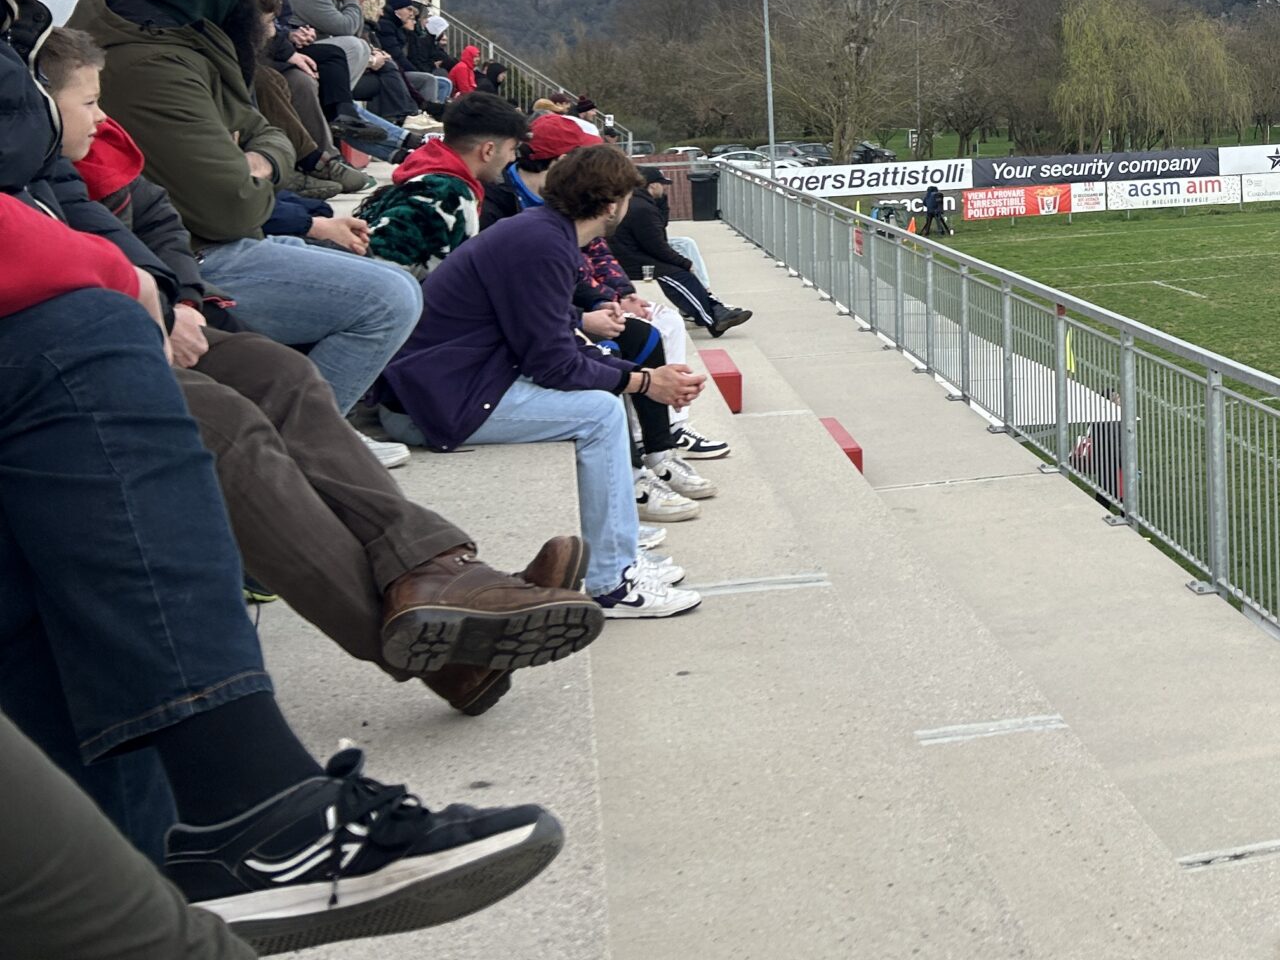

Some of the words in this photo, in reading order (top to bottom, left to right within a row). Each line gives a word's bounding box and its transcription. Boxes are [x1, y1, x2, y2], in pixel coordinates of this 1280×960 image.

[992, 163, 1036, 179] Your
[1040, 159, 1114, 178] security
[1118, 157, 1201, 176] company
[1187, 179, 1222, 194] aim
[967, 191, 986, 200] VIENI
[987, 191, 993, 199] A
[993, 189, 1025, 198] PROVARE
[968, 197, 1026, 208] L'IRRESISTIBILE
[968, 207, 995, 218] POLLO
[996, 206, 1026, 216] FRITTO
